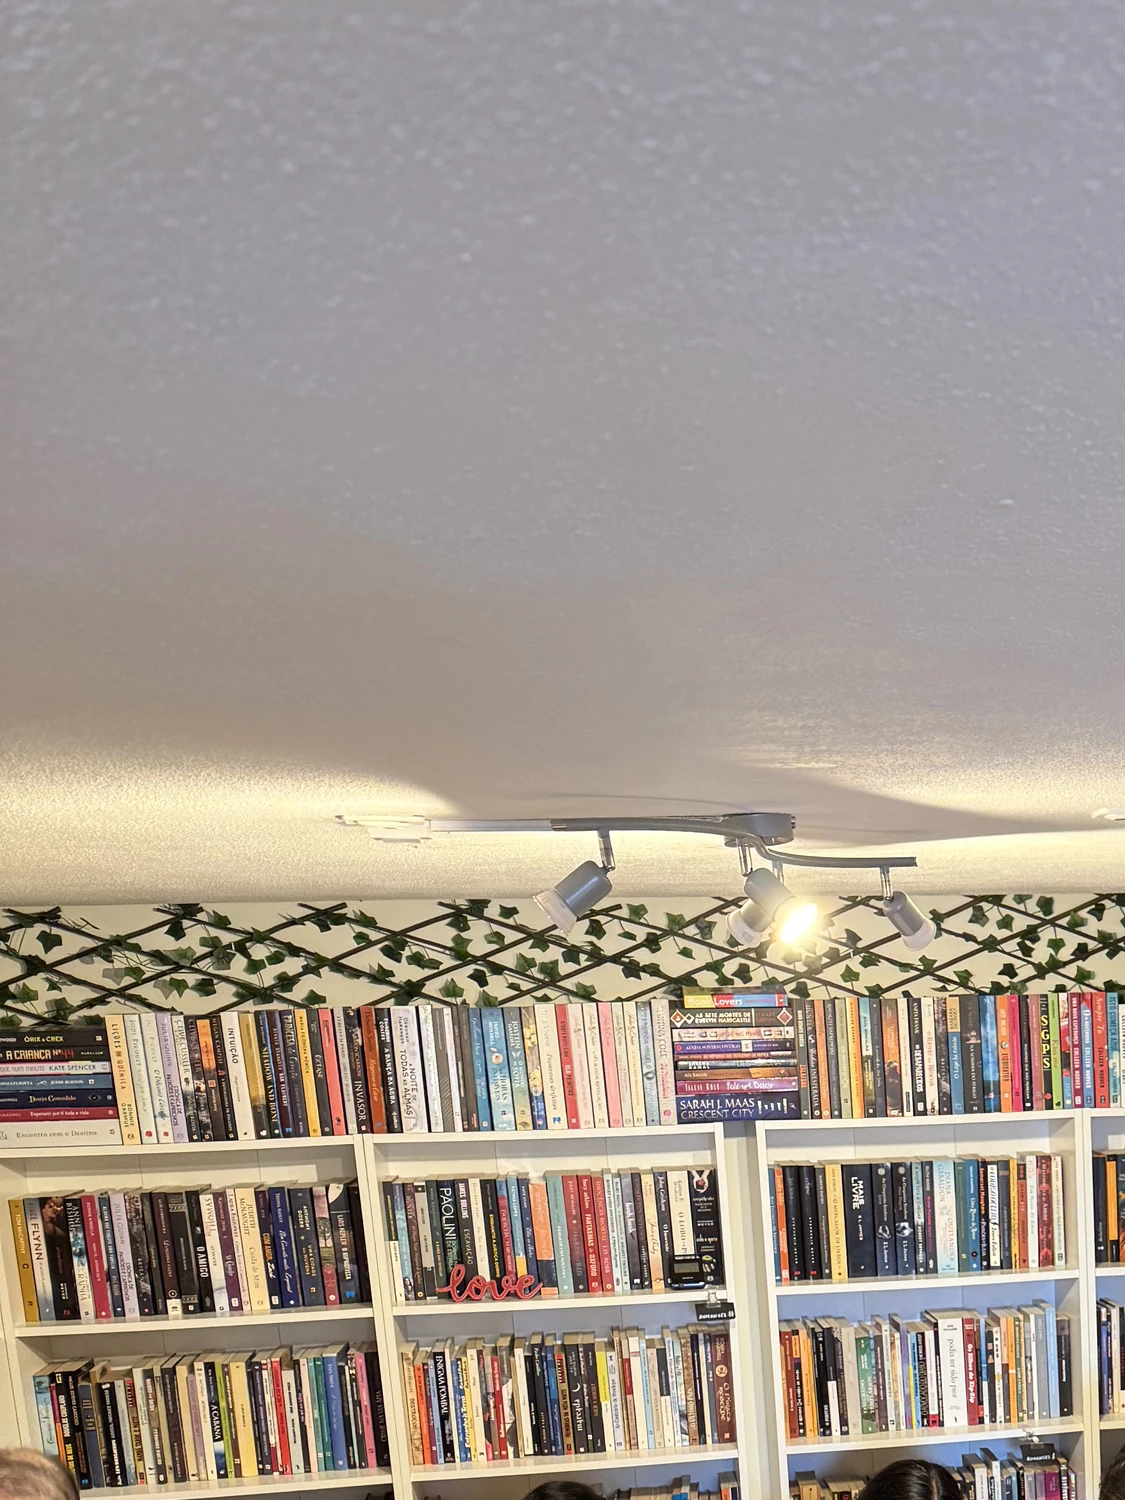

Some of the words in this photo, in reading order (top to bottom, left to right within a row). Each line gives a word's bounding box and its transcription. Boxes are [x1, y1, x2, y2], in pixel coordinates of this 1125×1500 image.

[714, 996, 742, 1005] Lovers
[227, 1028, 238, 1064] INTUIÇÃO
[384, 1054, 393, 1075] DANÇA
[400, 1049, 409, 1078] TODAS
[405, 1087, 413, 1115] ALMAS
[410, 1068, 418, 1093] NOITE
[354, 1081, 366, 1120] INVASOR
[388, 1086, 396, 1104] ÁGUA
[680, 1100, 715, 1110] SARAH
[725, 1098, 755, 1108] MAAS
[681, 1110, 729, 1119] CRESCENT
[732, 1109, 755, 1117] CITY
[851, 1176, 860, 1210] LIVRE
[857, 1180, 865, 1205] MAIS
[246, 1203, 256, 1229] JUDITH
[439, 1188, 456, 1240] PAOLINI
[31, 1223, 44, 1261] FLYNN
[463, 1229, 473, 1265] ESCAVAÇÃO
[198, 1253, 209, 1278] AMIGO
[436, 1263, 543, 1300] love
[947, 1339, 956, 1358] podia
[967, 1344, 973, 1352] Os
[435, 1356, 446, 1385] ENIGMA
[969, 1372, 974, 1380] do
[438, 1386, 449, 1415] POMBAL
[212, 1410, 221, 1440] CABANA
